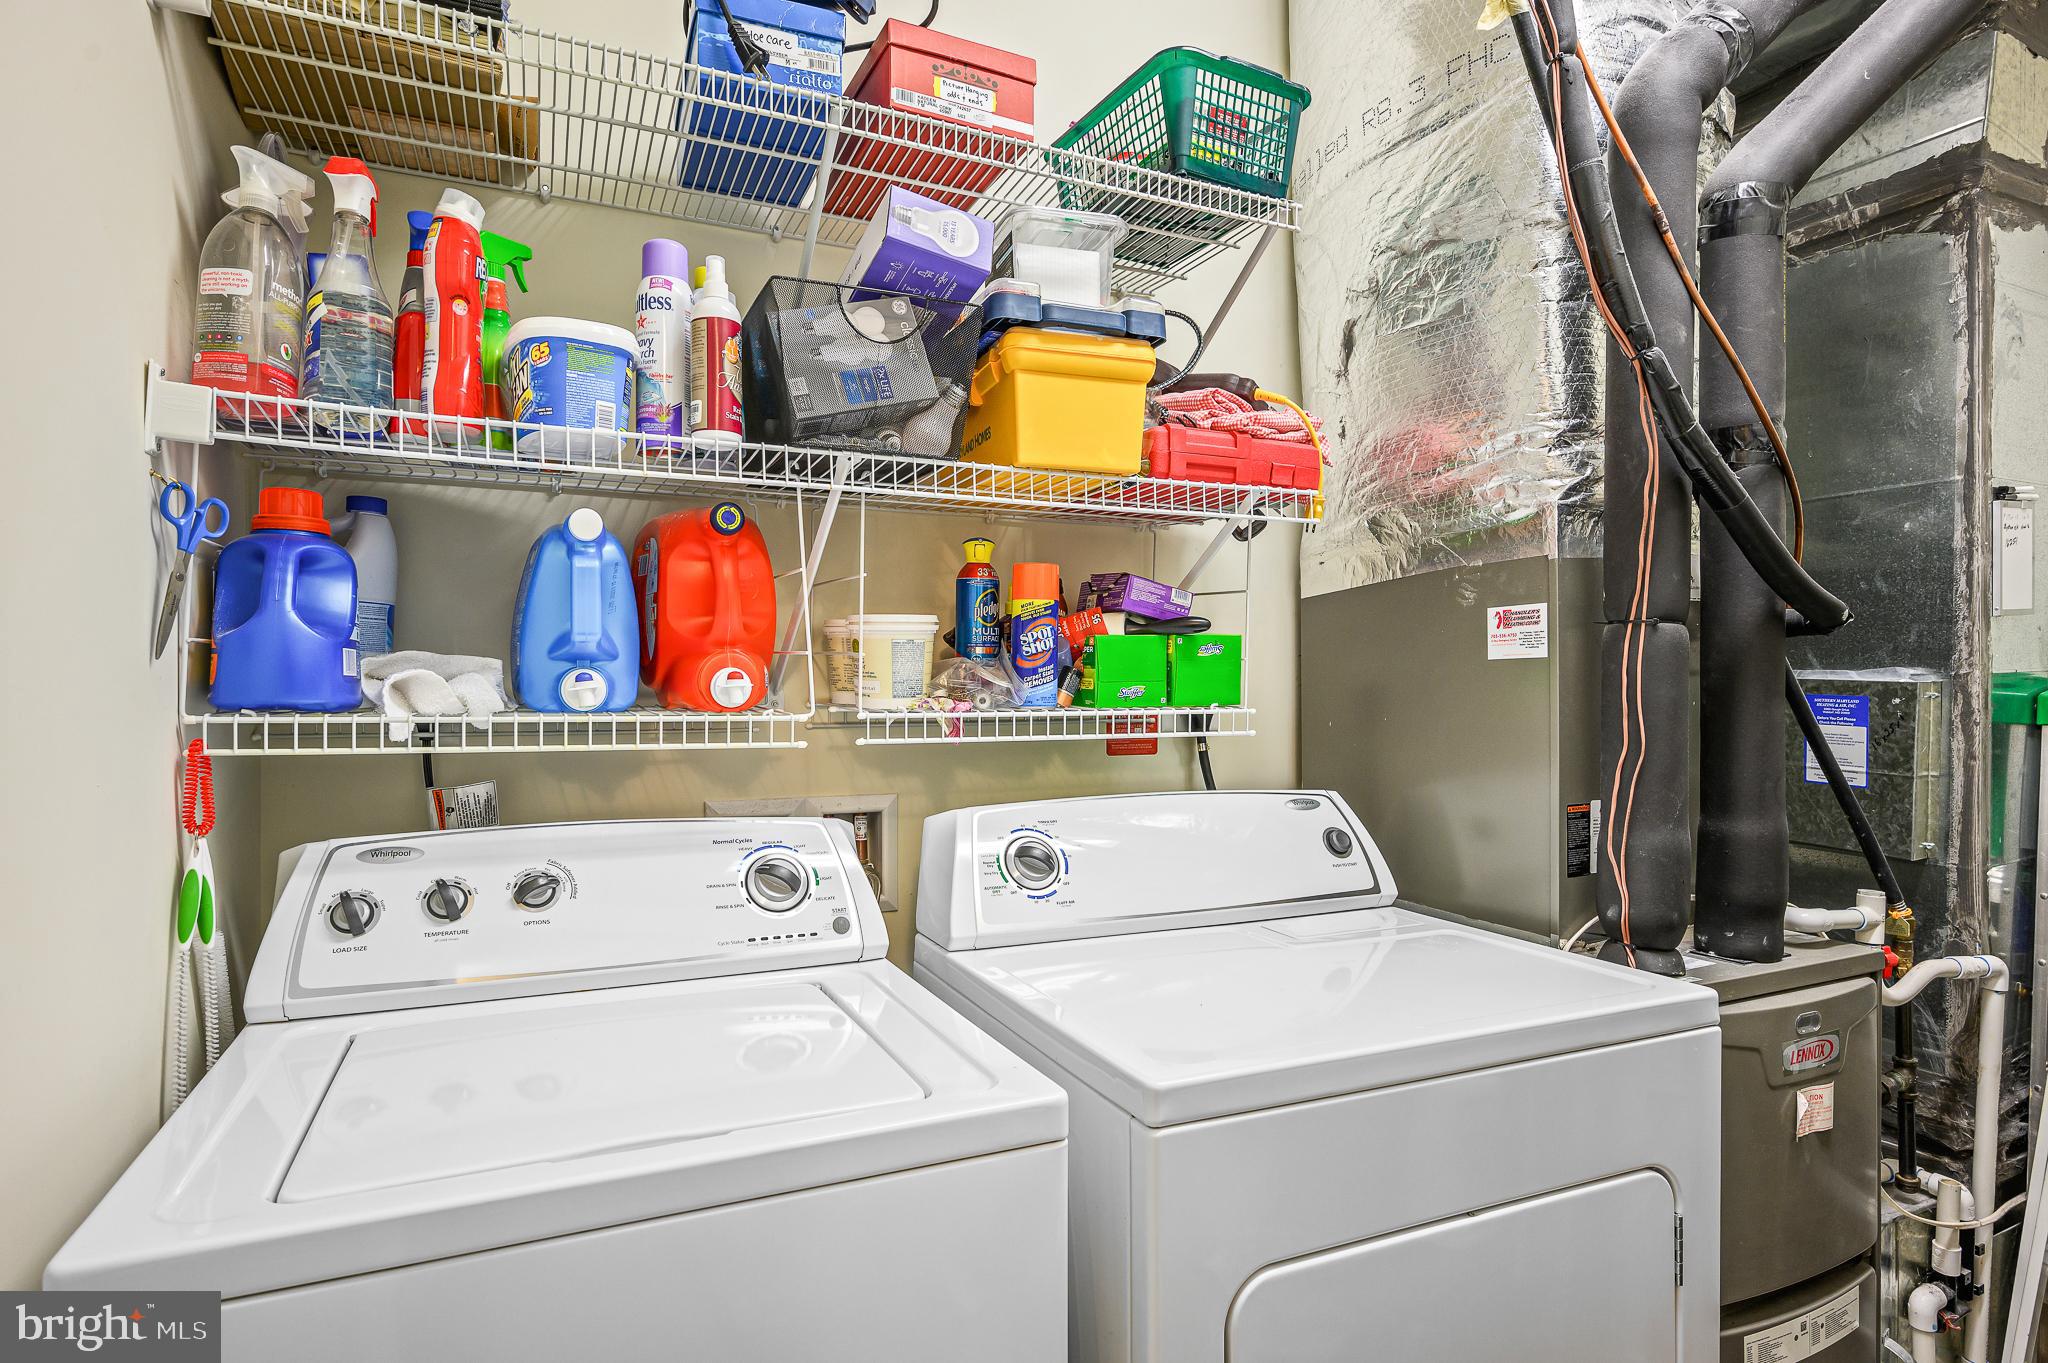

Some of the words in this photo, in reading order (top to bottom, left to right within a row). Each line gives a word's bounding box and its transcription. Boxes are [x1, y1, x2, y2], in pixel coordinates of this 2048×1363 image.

[765, 34, 793, 50] care
[1446, 32, 1512, 87] FHC
[788, 70, 832, 90] rialto
[942, 80, 965, 92] Picture
[965, 83, 989, 101] Hanging
[946, 91, 960, 100] odds
[968, 98, 984, 107] ends
[530, 340, 551, 362] 65
[974, 425, 992, 448] HOMES
[1020, 601, 1034, 609] MORE
[1020, 626, 1055, 646] SPOT
[1022, 638, 1055, 656] SHOT
[1024, 672, 1042, 682] Carpet
[1042, 669, 1054, 678] Stain
[1038, 664, 1054, 673] Instant
[370, 848, 412, 859] Whirlpool
[424, 928, 470, 938] TEMPERATURE
[1790, 1042, 1826, 1066] LENNOX
